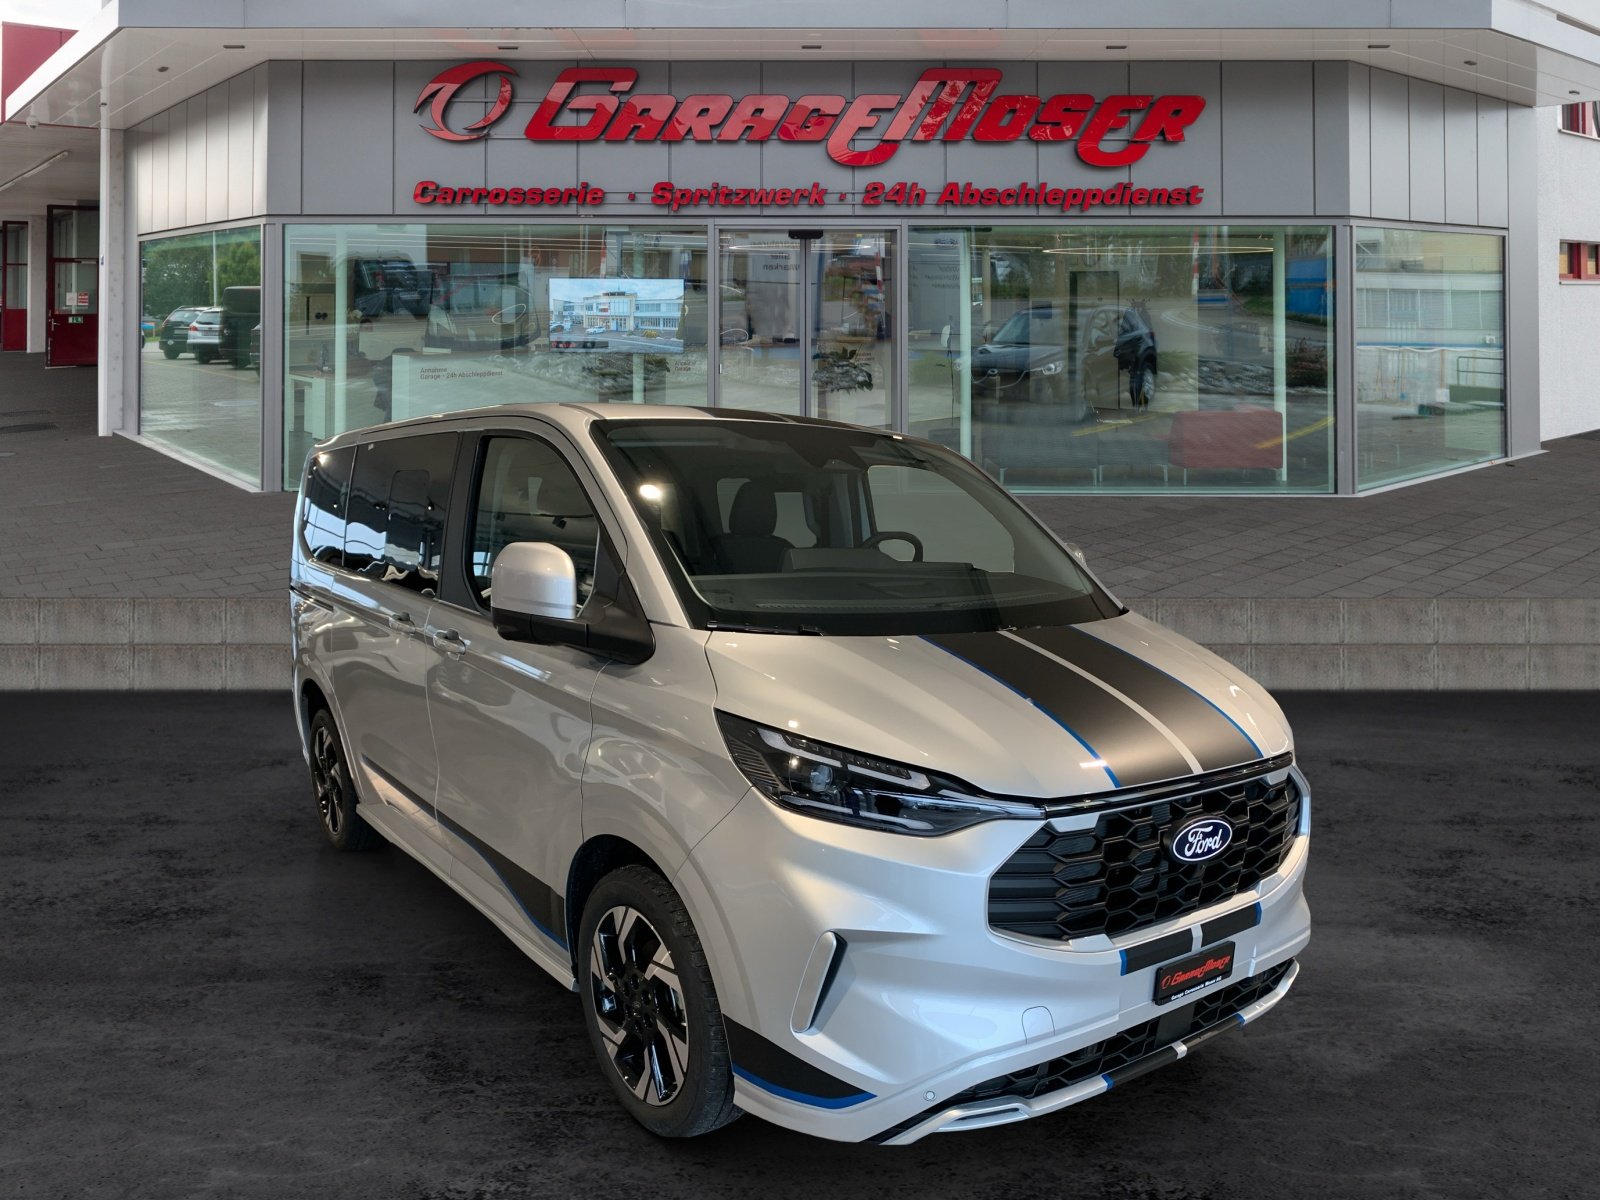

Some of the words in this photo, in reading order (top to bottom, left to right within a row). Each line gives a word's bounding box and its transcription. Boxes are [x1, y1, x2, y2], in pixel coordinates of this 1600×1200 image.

[412, 180, 605, 205] Carrosserie
[650, 181, 827, 211] Spritzwerk
[863, 181, 927, 206] 24h
[937, 181, 1204, 212] Abschleppdienst
[458, 370, 503, 378] Abschleppdienst
[1184, 825, 1223, 857] Ford
